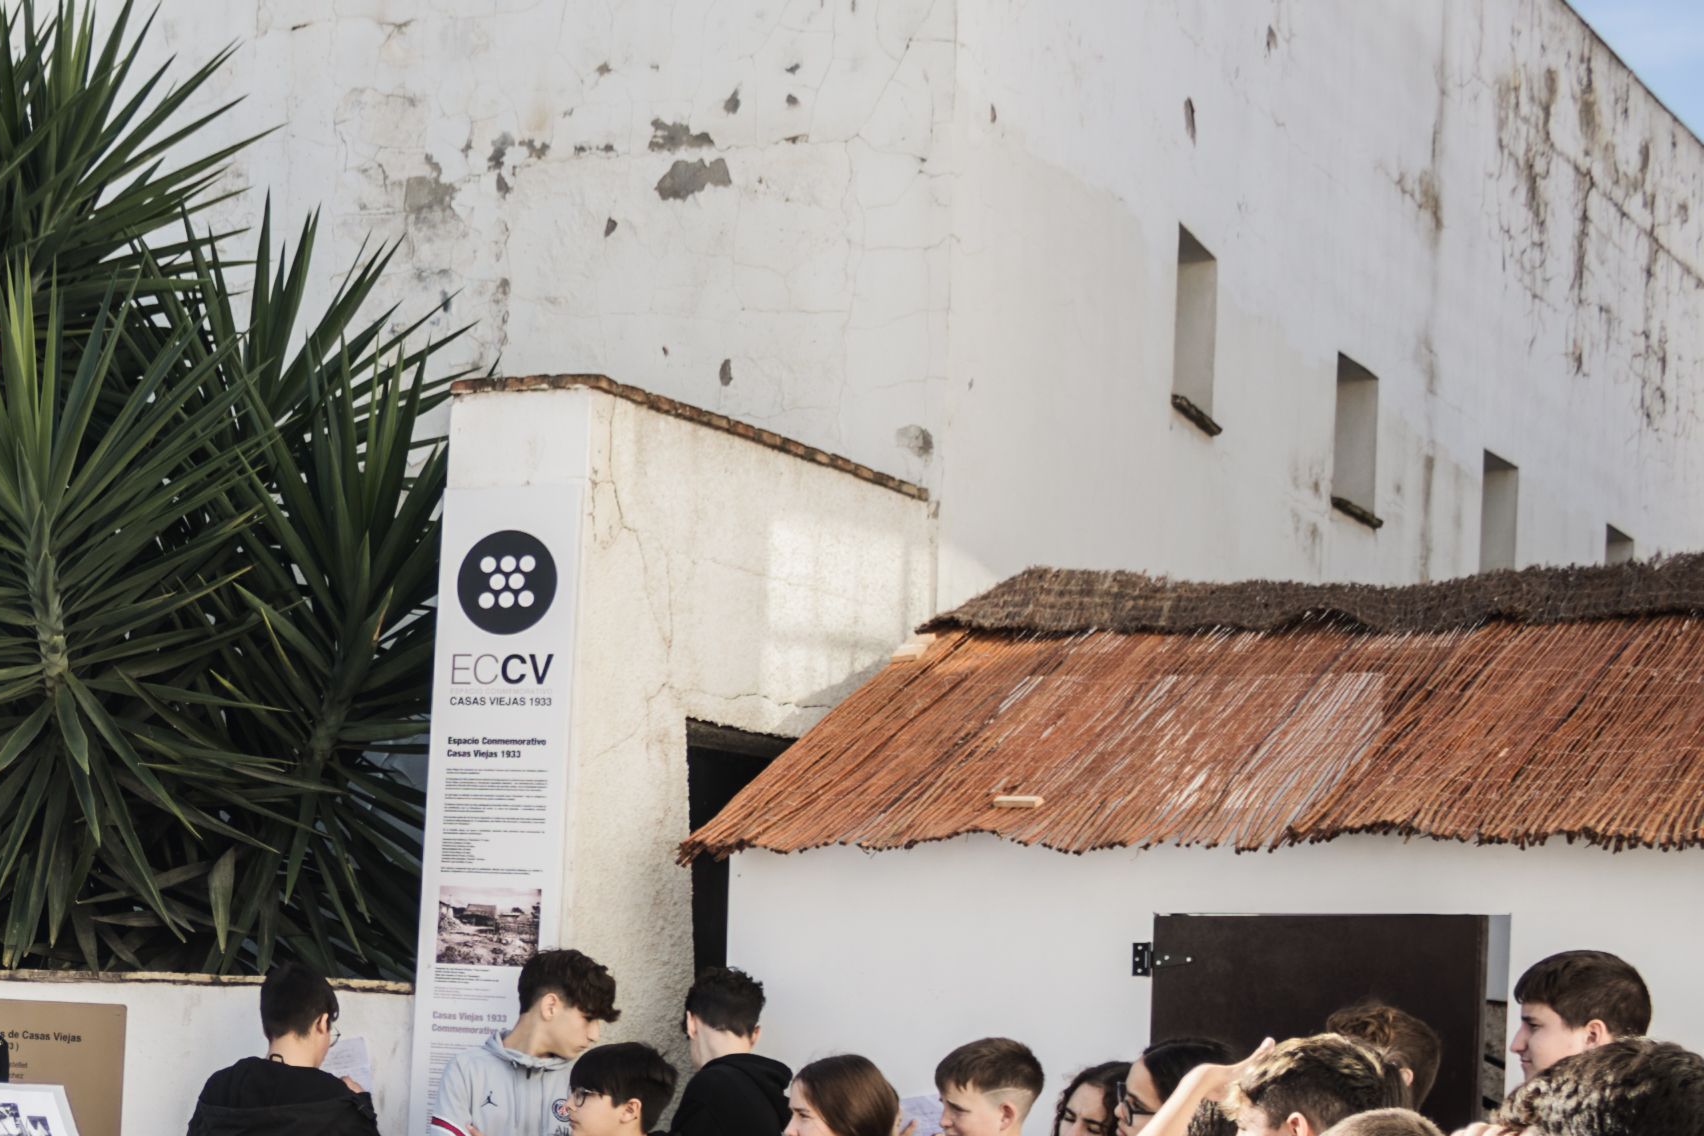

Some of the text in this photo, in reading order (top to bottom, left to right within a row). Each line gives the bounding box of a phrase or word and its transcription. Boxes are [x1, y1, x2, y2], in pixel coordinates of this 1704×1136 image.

[451, 653, 554, 685] ECCV
[449, 696, 552, 706] CASAS VIEJAS 1933
[447, 736, 547, 747] Espacio Conmemorativo
[447, 749, 521, 759] Casas Viejas 1933
[432, 1011, 507, 1022] Casas Viejas 1933
[8, 1029, 20, 1039] de
[22, 1030, 51, 1041] Casas
[53, 1031, 82, 1044] Viejas
